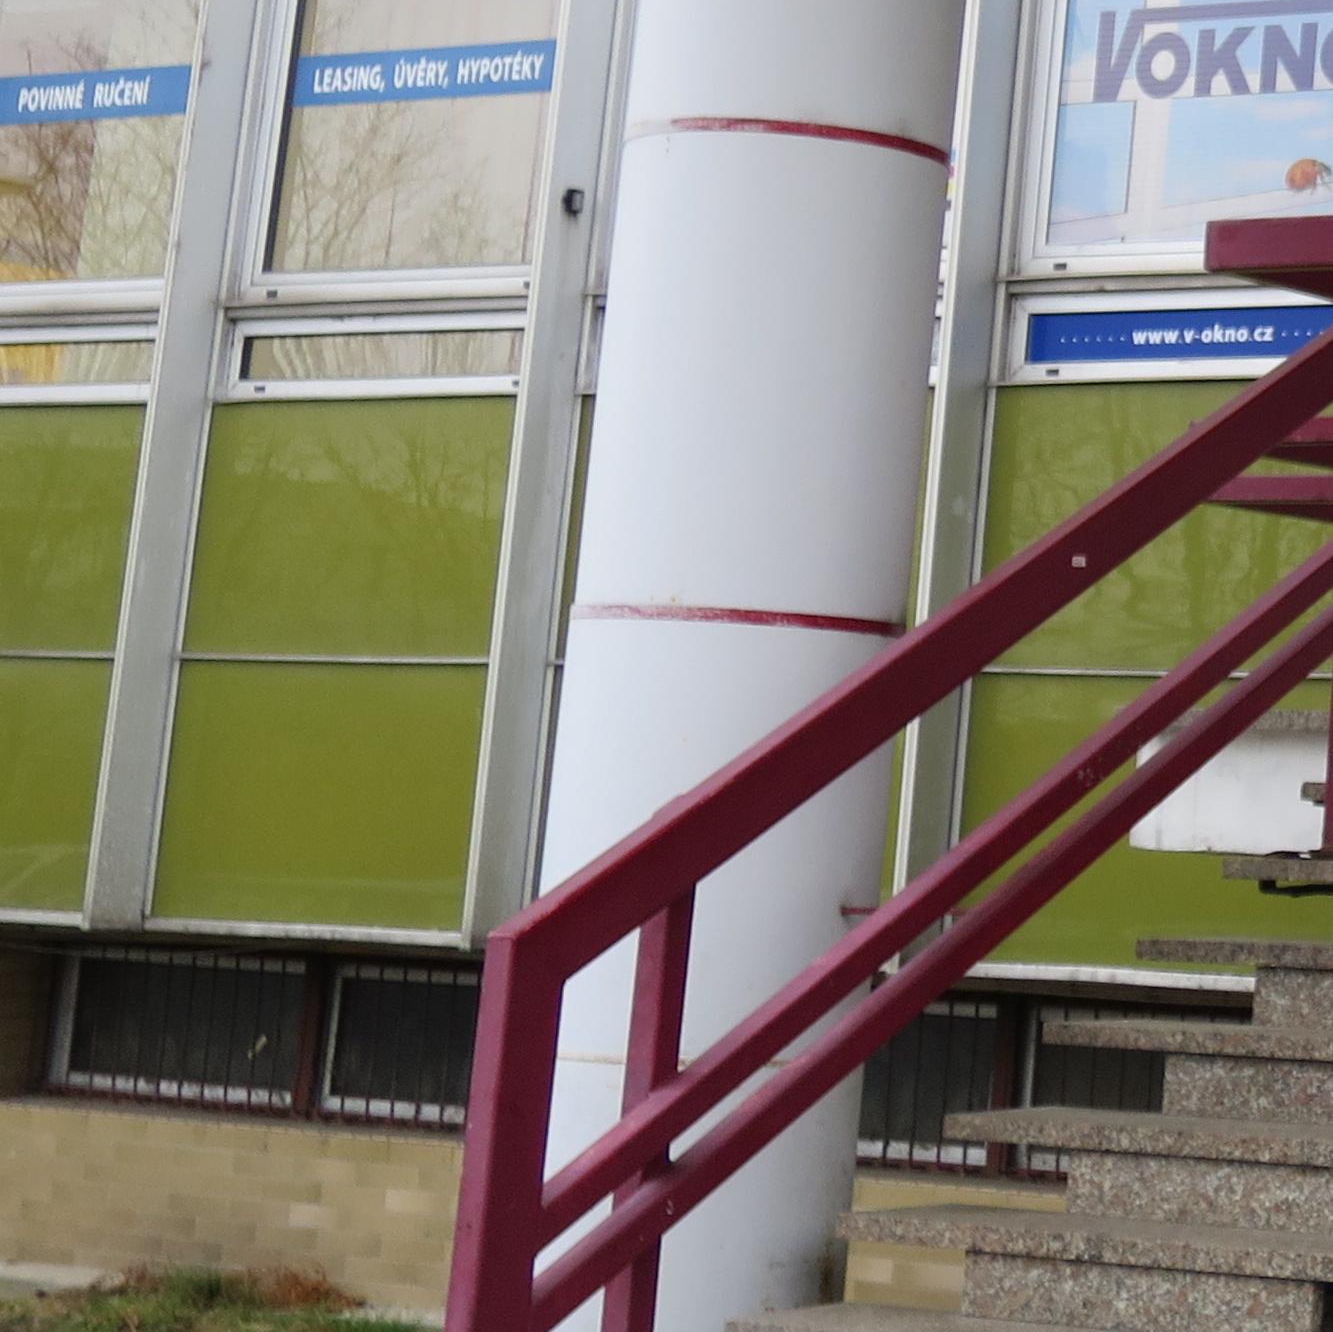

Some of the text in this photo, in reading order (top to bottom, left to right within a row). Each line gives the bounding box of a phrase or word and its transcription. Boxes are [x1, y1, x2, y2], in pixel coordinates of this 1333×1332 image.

[313, 51, 546, 95] LEASING, ÚVĚRY, HYPOTÉKY
[17, 75, 151, 112] POVINNÉ RUČENÍ
[1131, 322, 1276, 347] www.v-okno.cz
